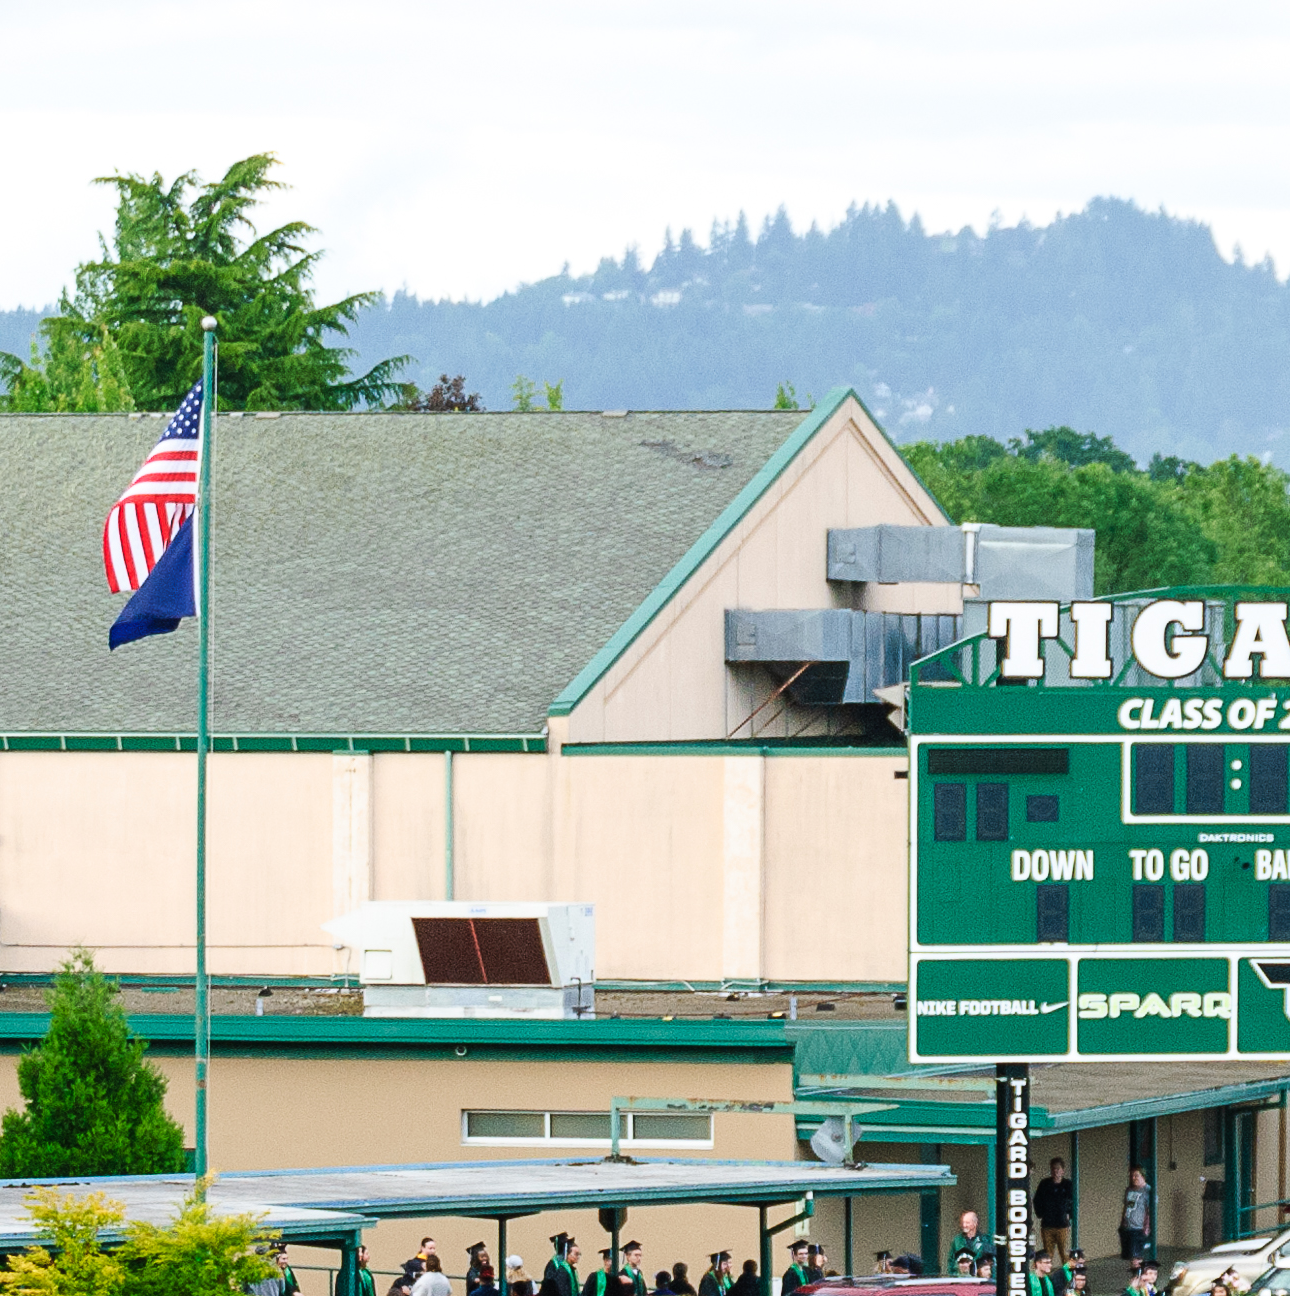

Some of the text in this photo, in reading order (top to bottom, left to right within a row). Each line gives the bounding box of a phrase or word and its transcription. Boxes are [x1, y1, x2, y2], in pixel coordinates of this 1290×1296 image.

[1118, 698, 1224, 729] CLASS
[1227, 698, 1278, 729] OF
[1198, 833, 1275, 843] DAKTRONICS
[1011, 849, 1095, 882] DOWN
[1128, 848, 1210, 882] TO GO
[916, 1000, 1039, 1016] NIKE FOOTBALL
[1078, 992, 1233, 1019] SPARQ
[1009, 1079, 1028, 1179] TIGARD
